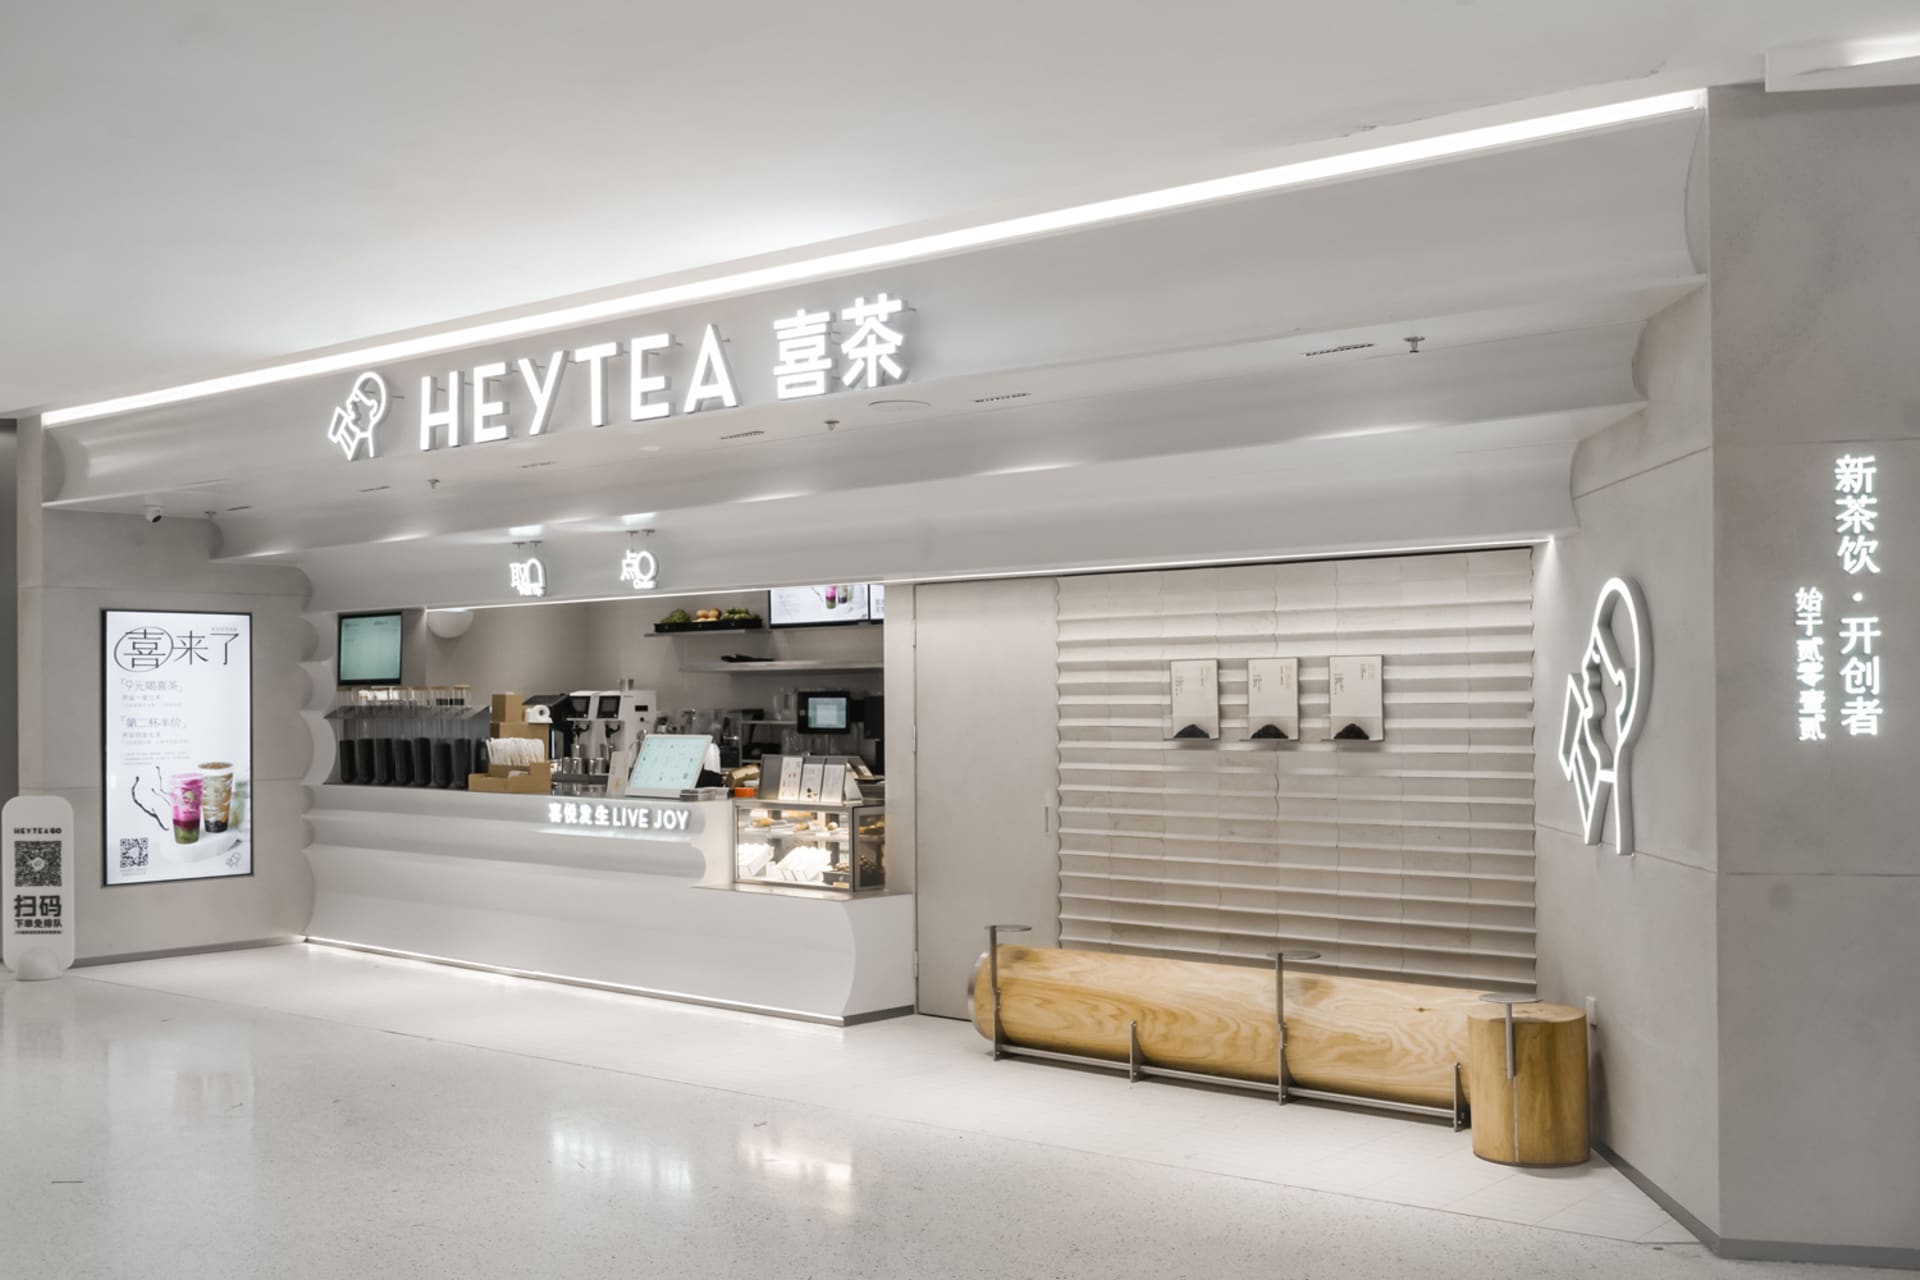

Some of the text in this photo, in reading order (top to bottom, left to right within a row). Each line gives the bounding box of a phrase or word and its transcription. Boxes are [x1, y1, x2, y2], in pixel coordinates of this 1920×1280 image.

[420, 292, 909, 451] HEYTEA 喜茶
[1834, 454, 1883, 737] 新茶饮·开创者
[122, 628, 240, 669] 喜来了
[612, 807, 649, 828] LIVE
[653, 809, 689, 831] JOY
[14, 894, 62, 917] 扫码
